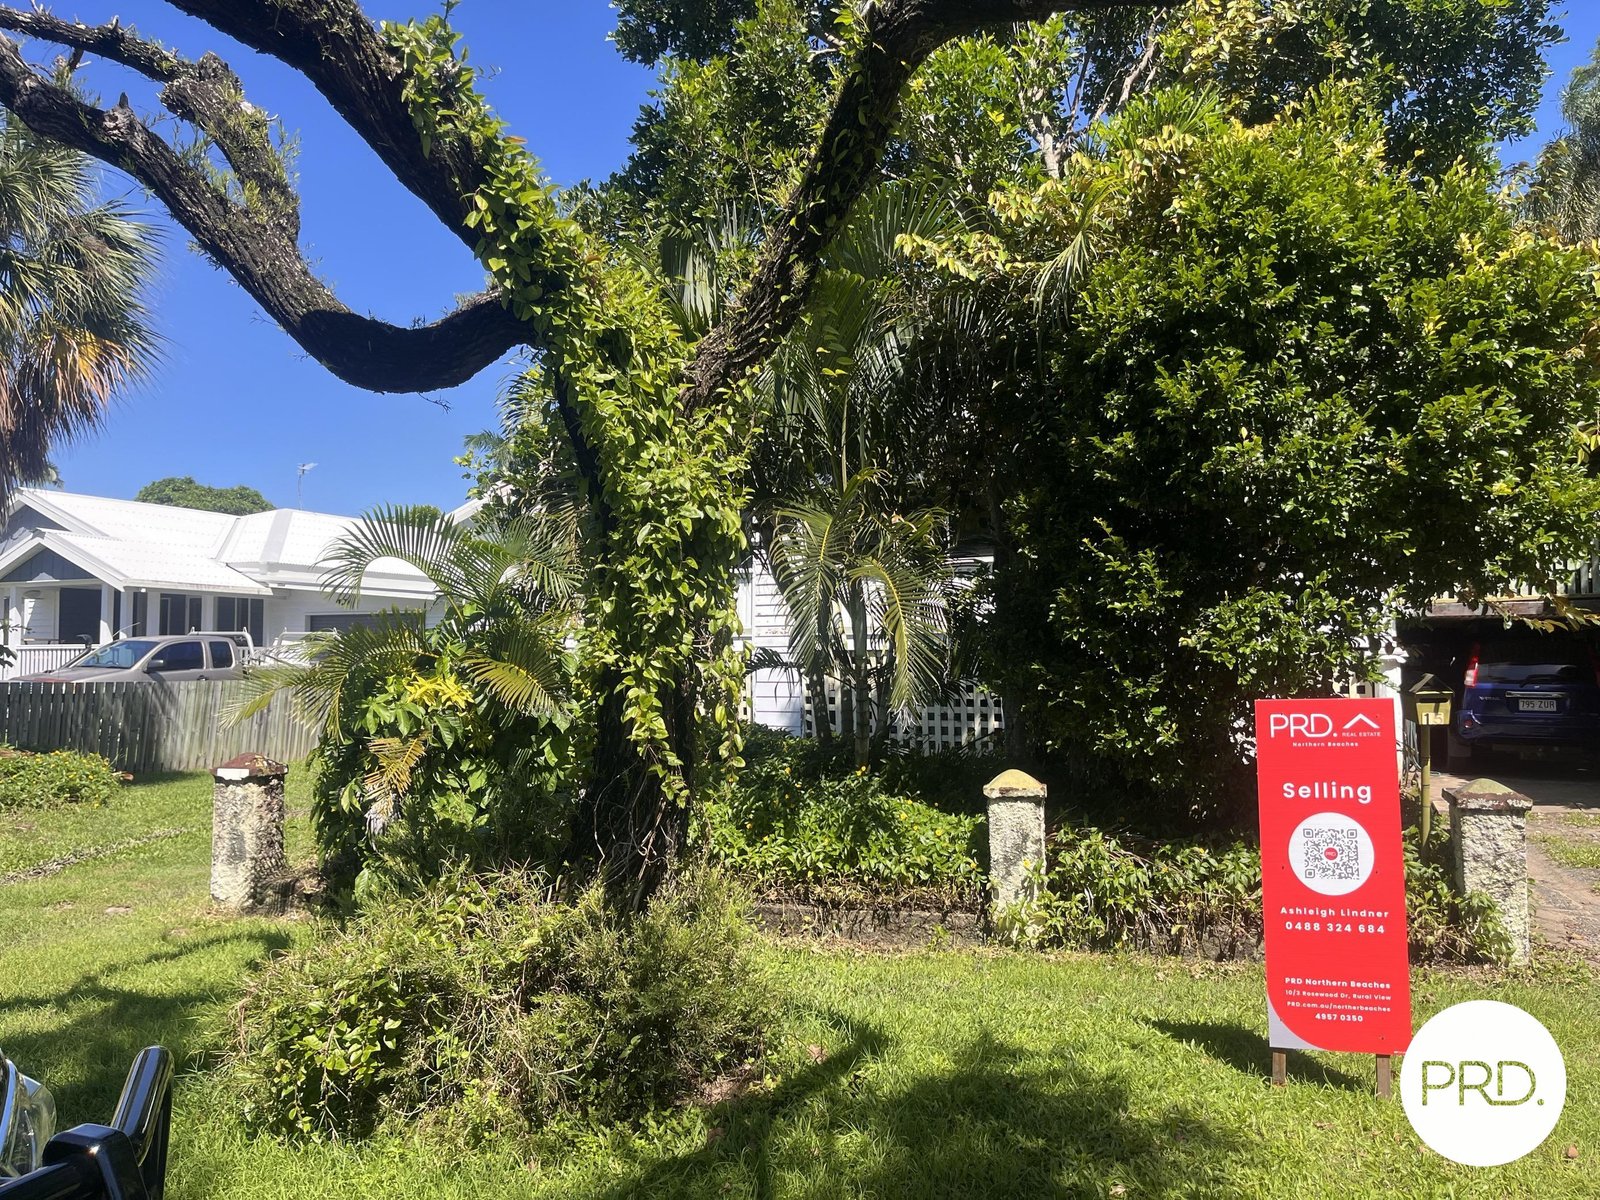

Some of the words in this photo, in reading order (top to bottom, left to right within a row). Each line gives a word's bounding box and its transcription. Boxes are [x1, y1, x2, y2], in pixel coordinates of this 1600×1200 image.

[1520, 700, 1535, 709] 795
[1538, 700, 1555, 710] ZUR
[1269, 713, 1338, 738] PRD.
[1283, 781, 1372, 804] Selling
[1280, 907, 1335, 918] Ashleigh
[1340, 909, 1389, 918] Lindner
[1285, 922, 1321, 931] 0488
[1327, 923, 1352, 932] 324
[1358, 925, 1385, 934] 684
[1285, 977, 1303, 985] PRD
[1305, 978, 1347, 987] Northern
[1350, 981, 1391, 989] Beaches
[1340, 1014, 1363, 1022] 0350
